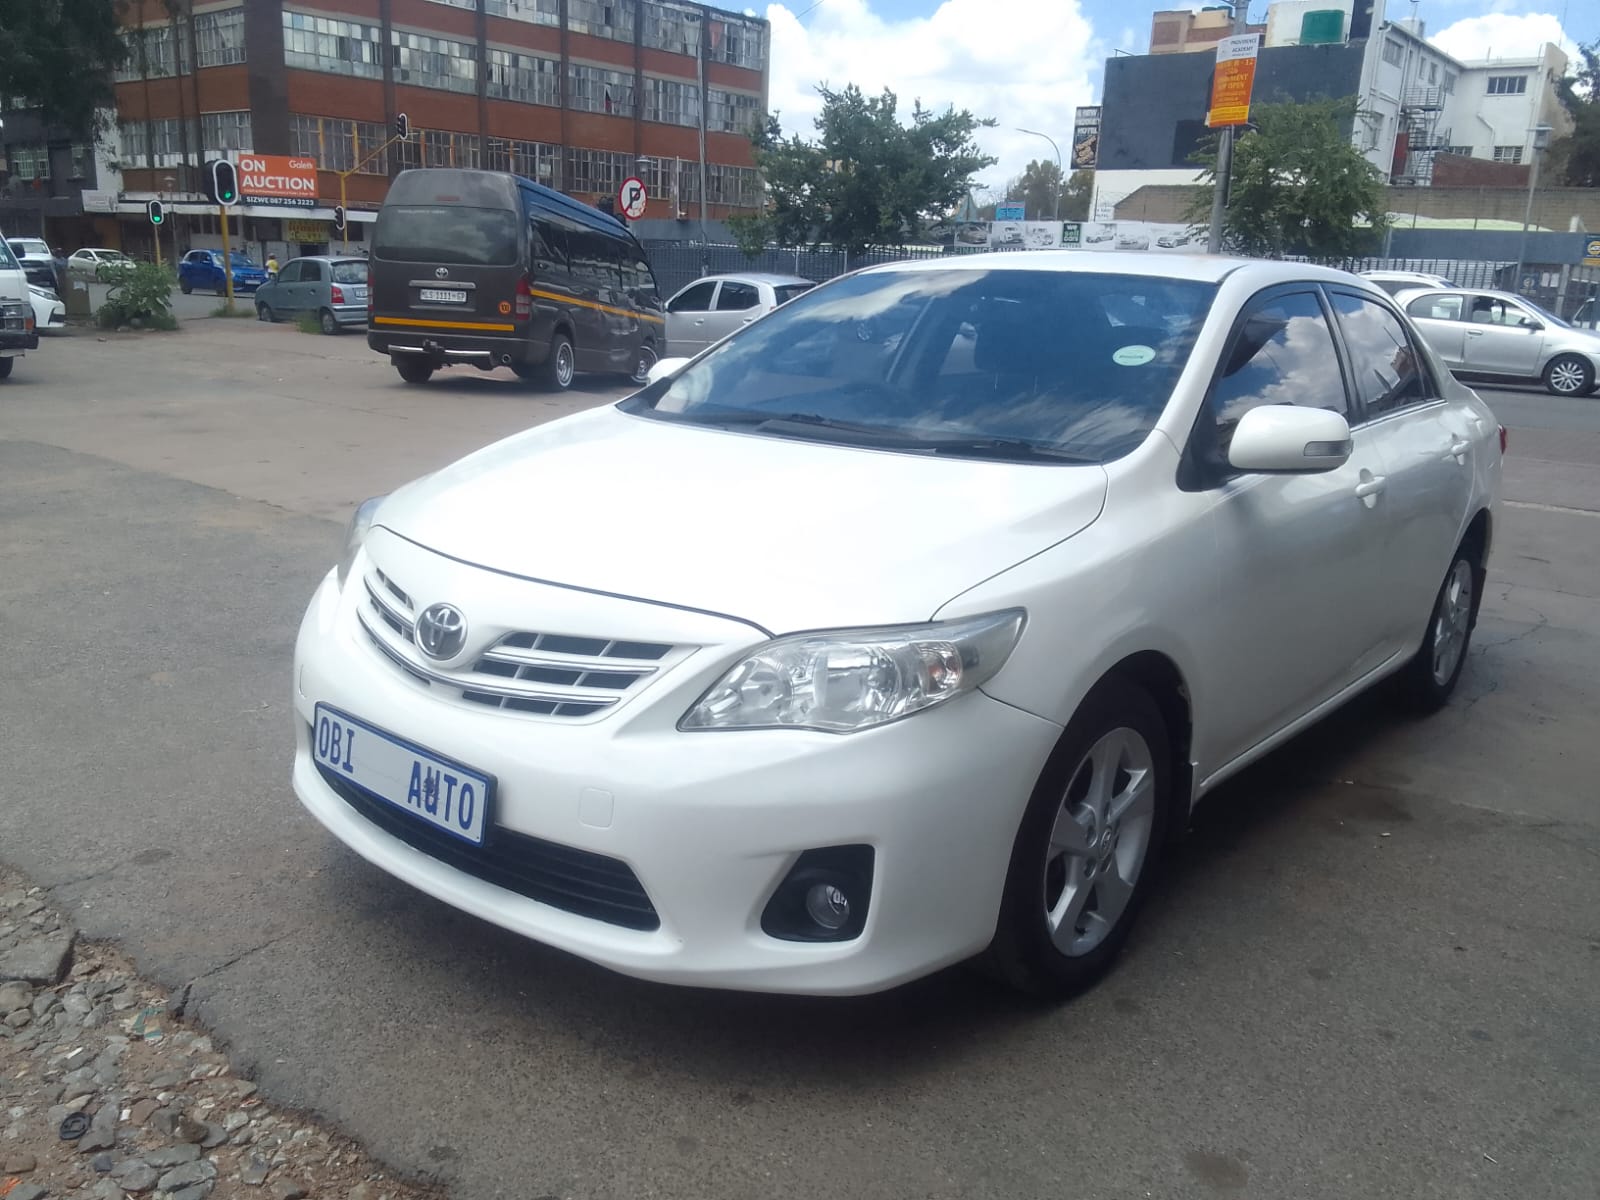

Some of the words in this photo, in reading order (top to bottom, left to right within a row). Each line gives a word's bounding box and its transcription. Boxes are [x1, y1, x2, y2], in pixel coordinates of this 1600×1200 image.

[240, 159, 266, 173] ON
[242, 174, 315, 191] AUCTION
[246, 196, 269, 204] SIZWE
[319, 716, 355, 774] OBI
[407, 760, 475, 830] AUTO
